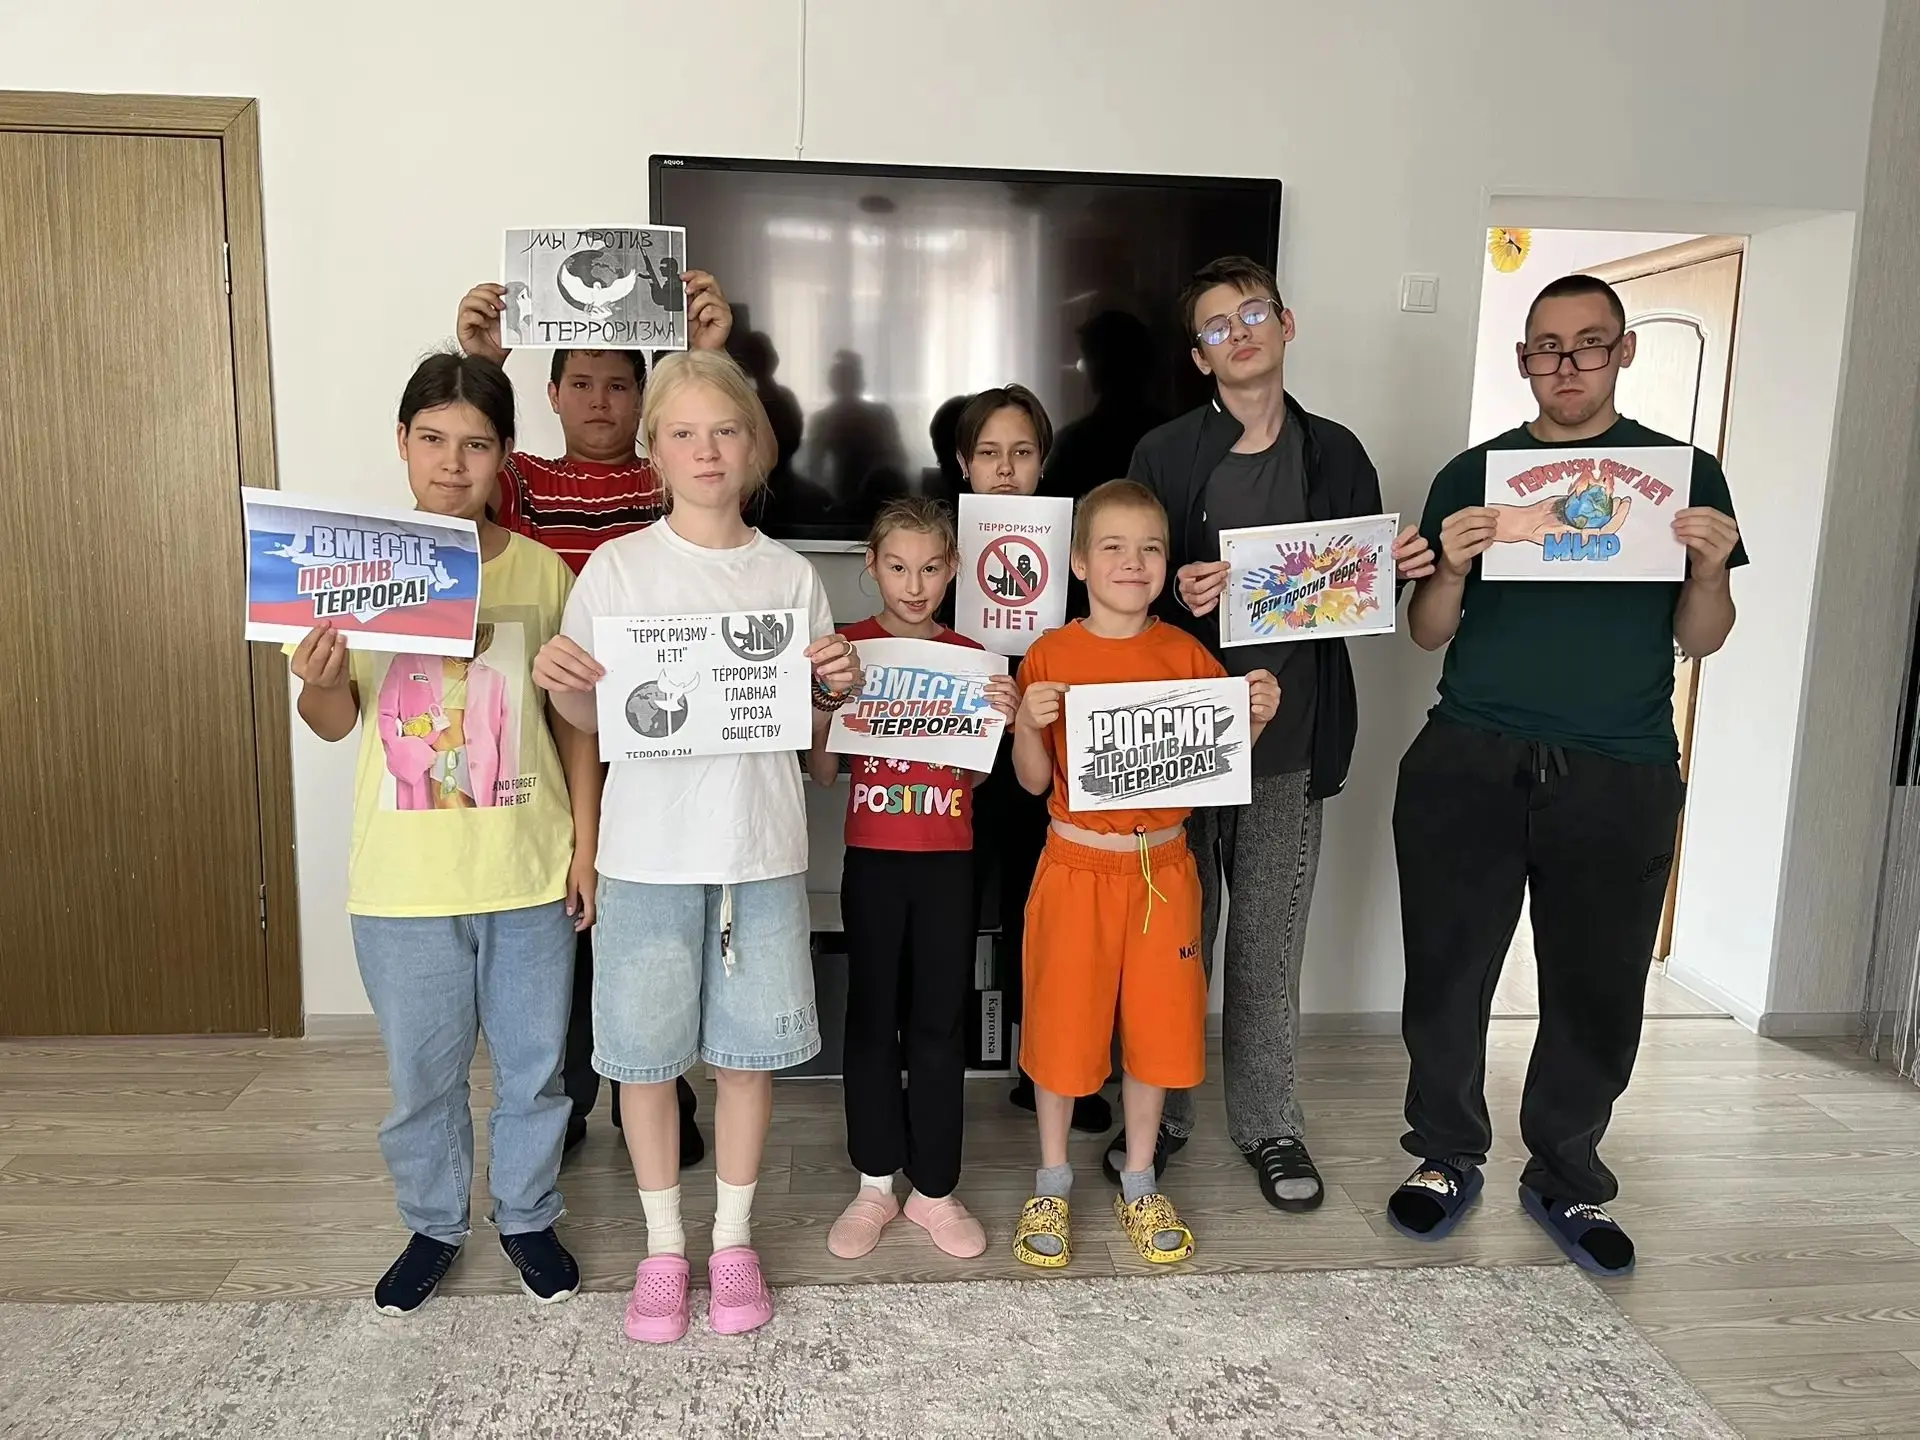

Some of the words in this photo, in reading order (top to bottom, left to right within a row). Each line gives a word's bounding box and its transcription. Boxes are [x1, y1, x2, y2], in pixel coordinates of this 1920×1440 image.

[521, 232, 566, 254] МЫ
[575, 231, 653, 249] ПРОТИВ
[538, 321, 676, 342] ТЕРРОРИЗМА
[978, 522, 1052, 534] ТЕРРОРИЗМУ
[312, 525, 437, 566] ВМЕСТЕ
[1542, 532, 1621, 561] МИР
[300, 559, 392, 592] ПРОТИВ
[314, 578, 426, 615] ТЕРРОРА!
[1284, 575, 1326, 607] против
[983, 608, 1038, 630] НЕТ
[712, 666, 777, 682] ТЕРРОРИЗМ
[725, 686, 777, 702] ГЛАВНАЯ
[863, 665, 983, 712] ВМЕСТЕ
[730, 706, 773, 721] УГРОЗА
[857, 700, 953, 718] ПРОТИВ
[722, 724, 781, 741] ОБЩЕСТВУ
[869, 718, 983, 735] ТЕРРОРА!
[1092, 705, 1215, 751] РОССИЯ
[1096, 737, 1180, 777] ПРОТИВ
[493, 780, 510, 791] AND
[512, 777, 537, 789] FORGET
[1111, 750, 1214, 796] ТЕРРОРА!
[500, 796, 514, 806] THE
[853, 783, 963, 817] POSITIVE
[986, 998, 998, 1054] Картотека
